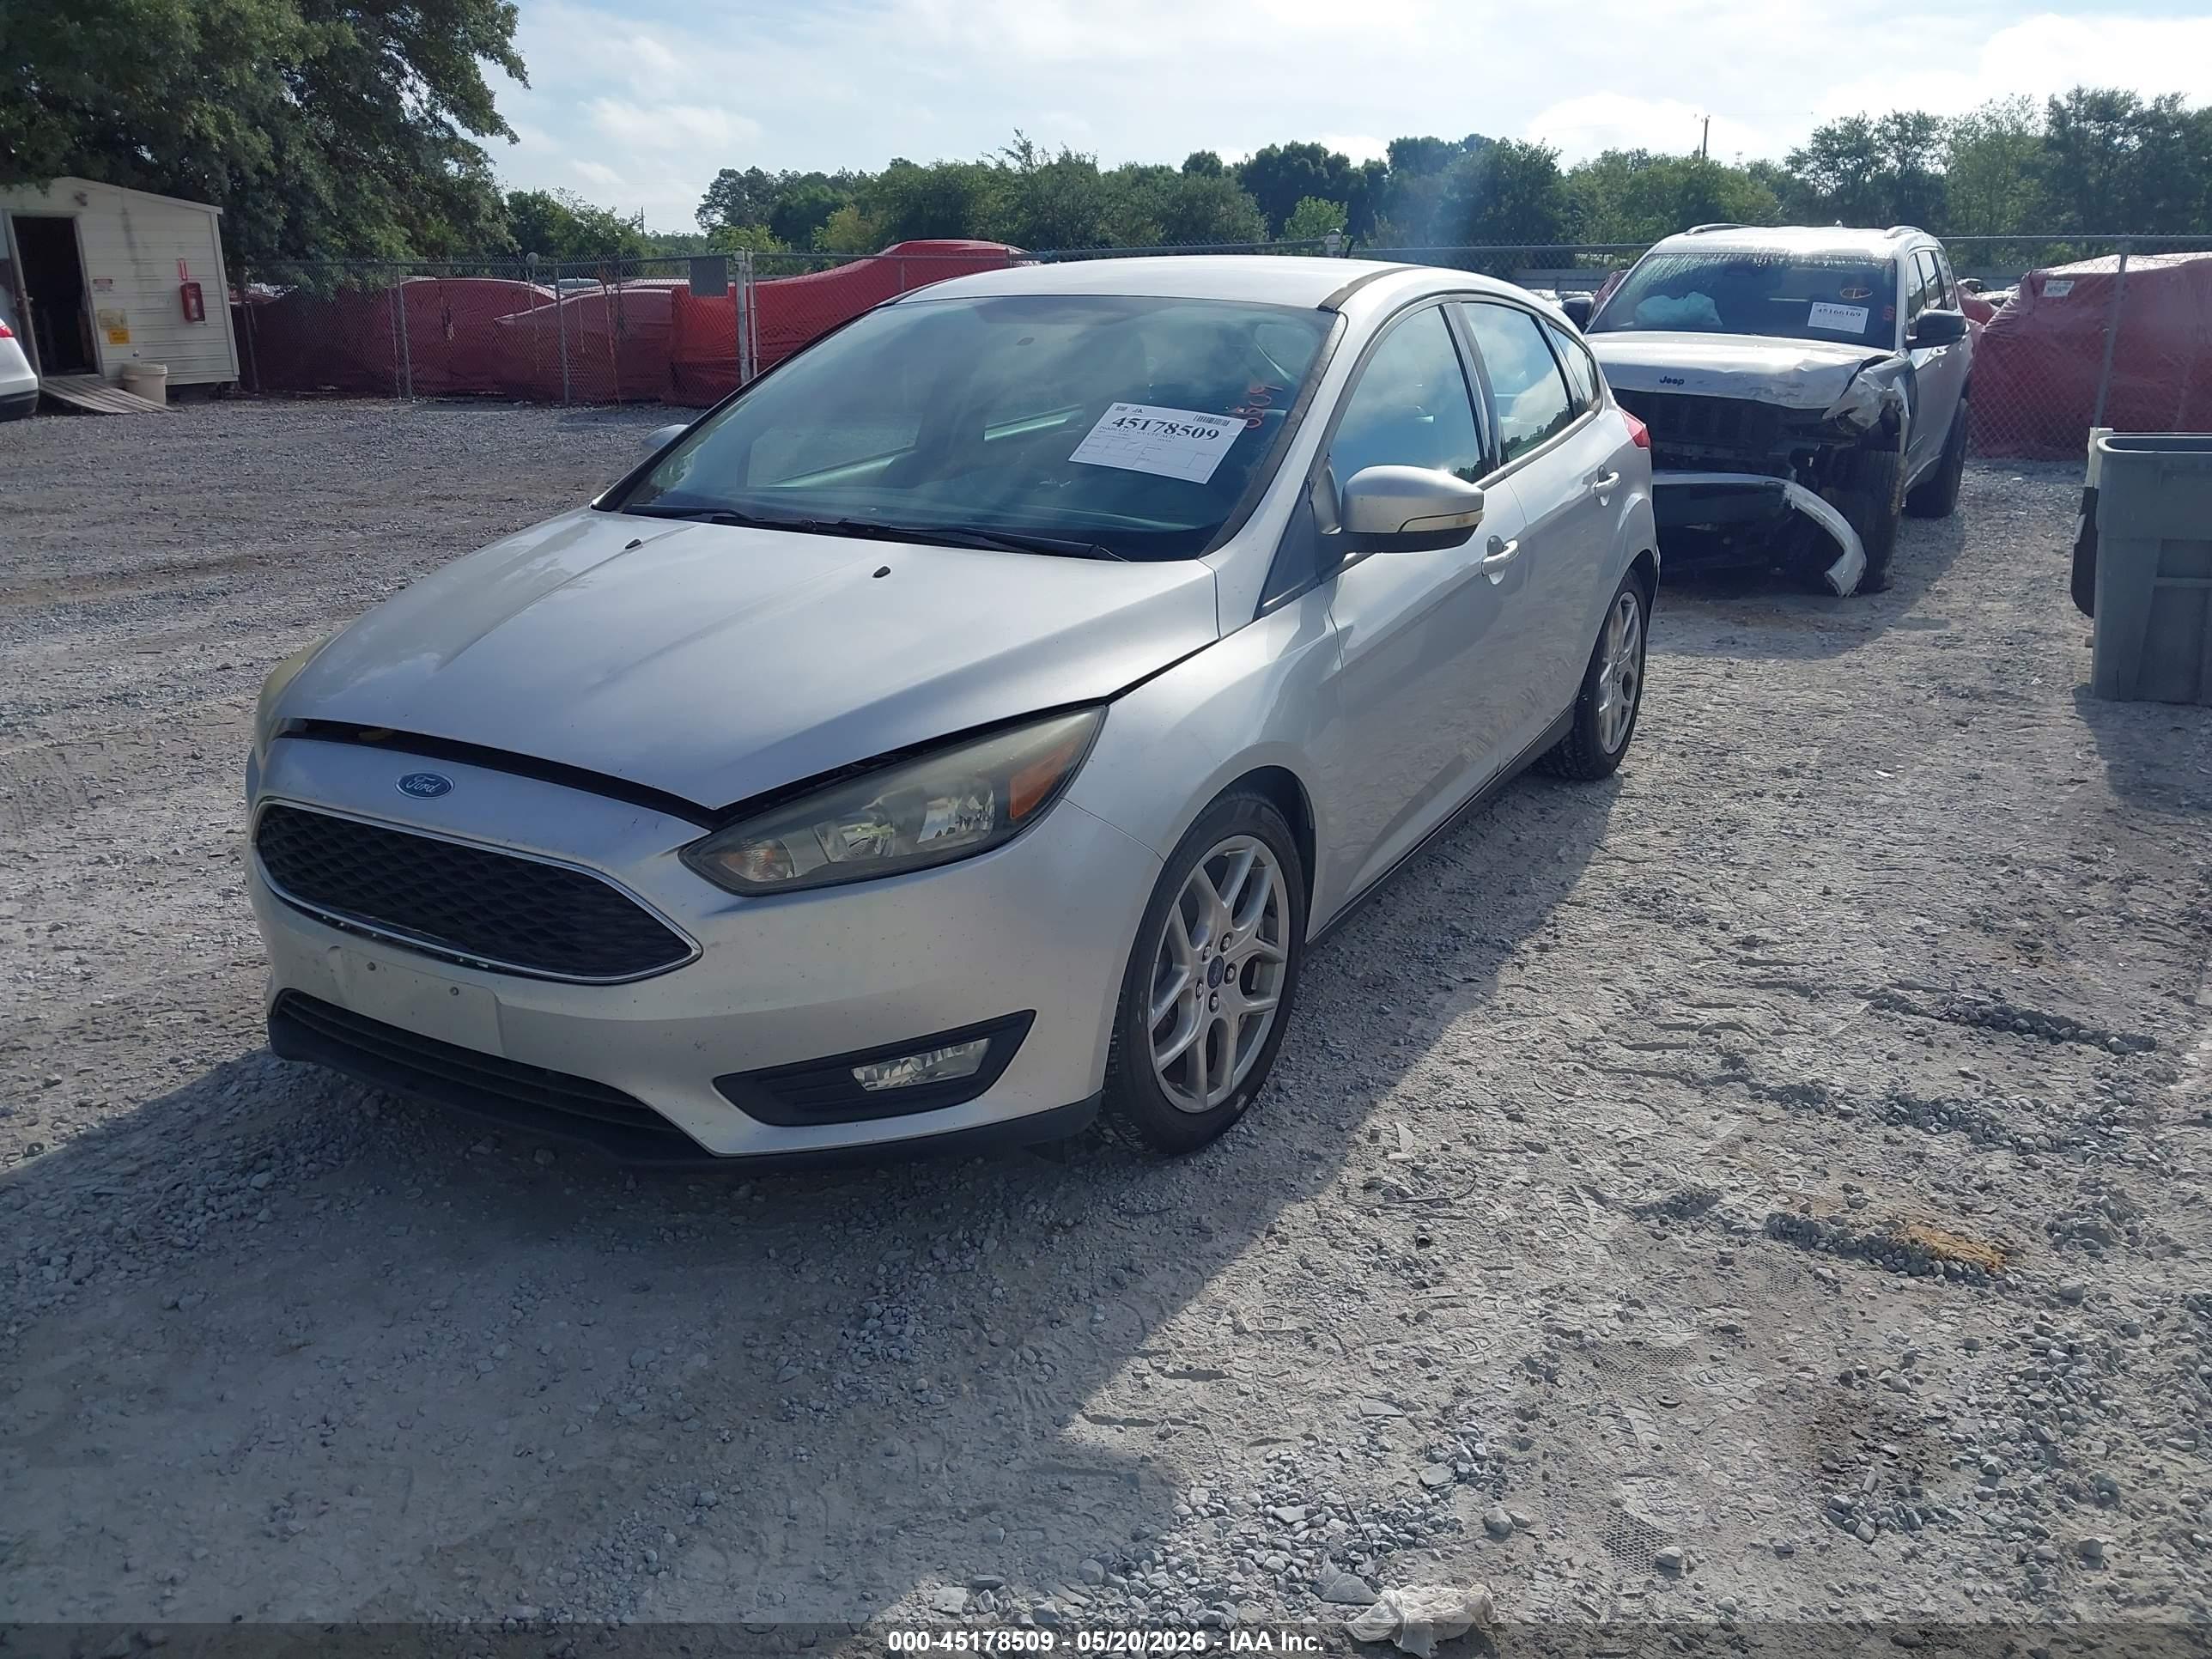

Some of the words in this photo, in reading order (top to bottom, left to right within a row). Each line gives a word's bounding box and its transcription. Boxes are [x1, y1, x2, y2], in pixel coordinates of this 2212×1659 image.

[1659, 375, 1685, 386] Jeep
[1112, 416, 1219, 441] 45178509
[406, 775, 441, 793] Ford
